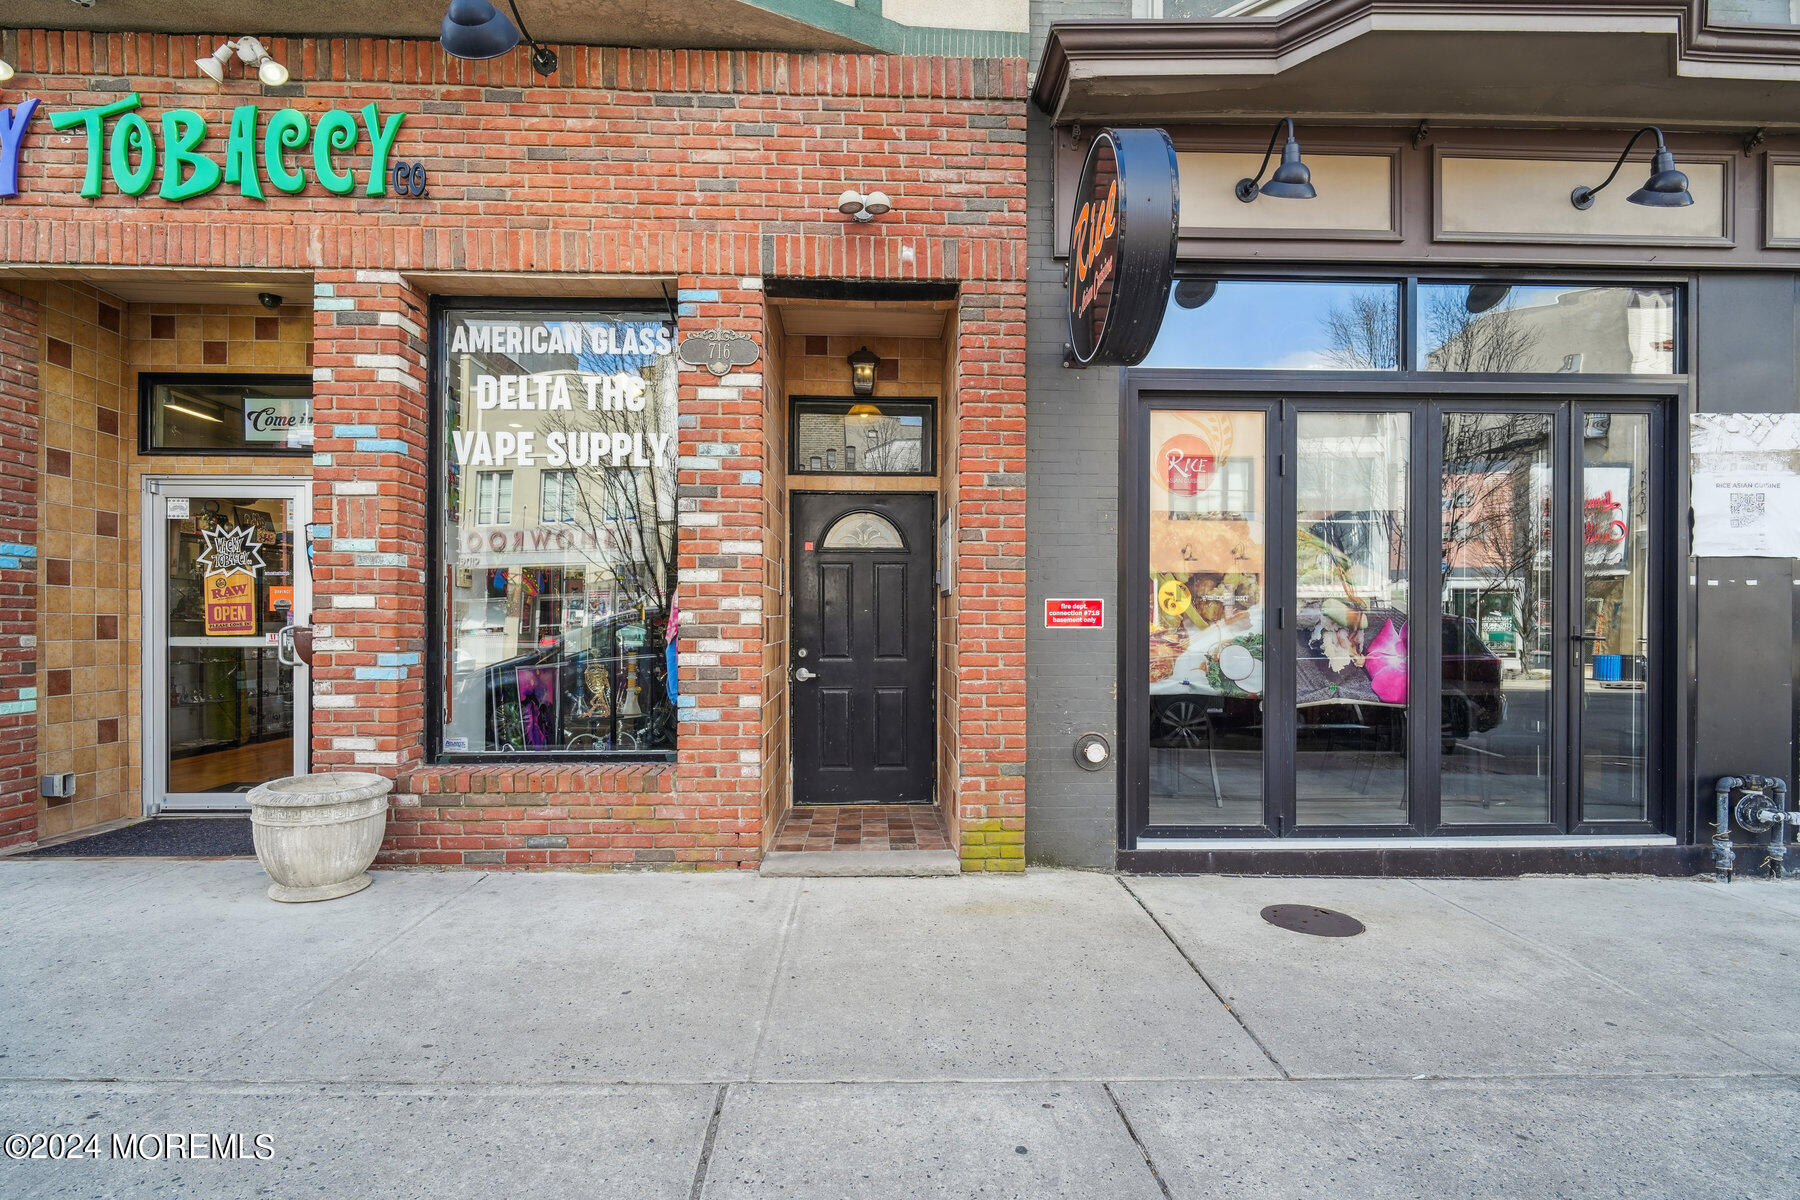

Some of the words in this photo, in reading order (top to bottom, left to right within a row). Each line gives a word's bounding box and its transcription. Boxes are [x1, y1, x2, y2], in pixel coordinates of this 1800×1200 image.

[49, 92, 406, 201] TOBACCY
[1073, 179, 1116, 313] Rice
[451, 325, 582, 354] AMERICAN
[592, 327, 672, 355] GLASS
[708, 342, 731, 359] 716
[476, 374, 572, 411] DELTA
[582, 375, 646, 412] THC
[246, 407, 297, 432] Come
[452, 430, 535, 466] VAPE
[546, 431, 670, 467] SUPPLY
[1165, 448, 1208, 478] RICE
[211, 584, 248, 599] RAW
[214, 605, 247, 621] OPEN
